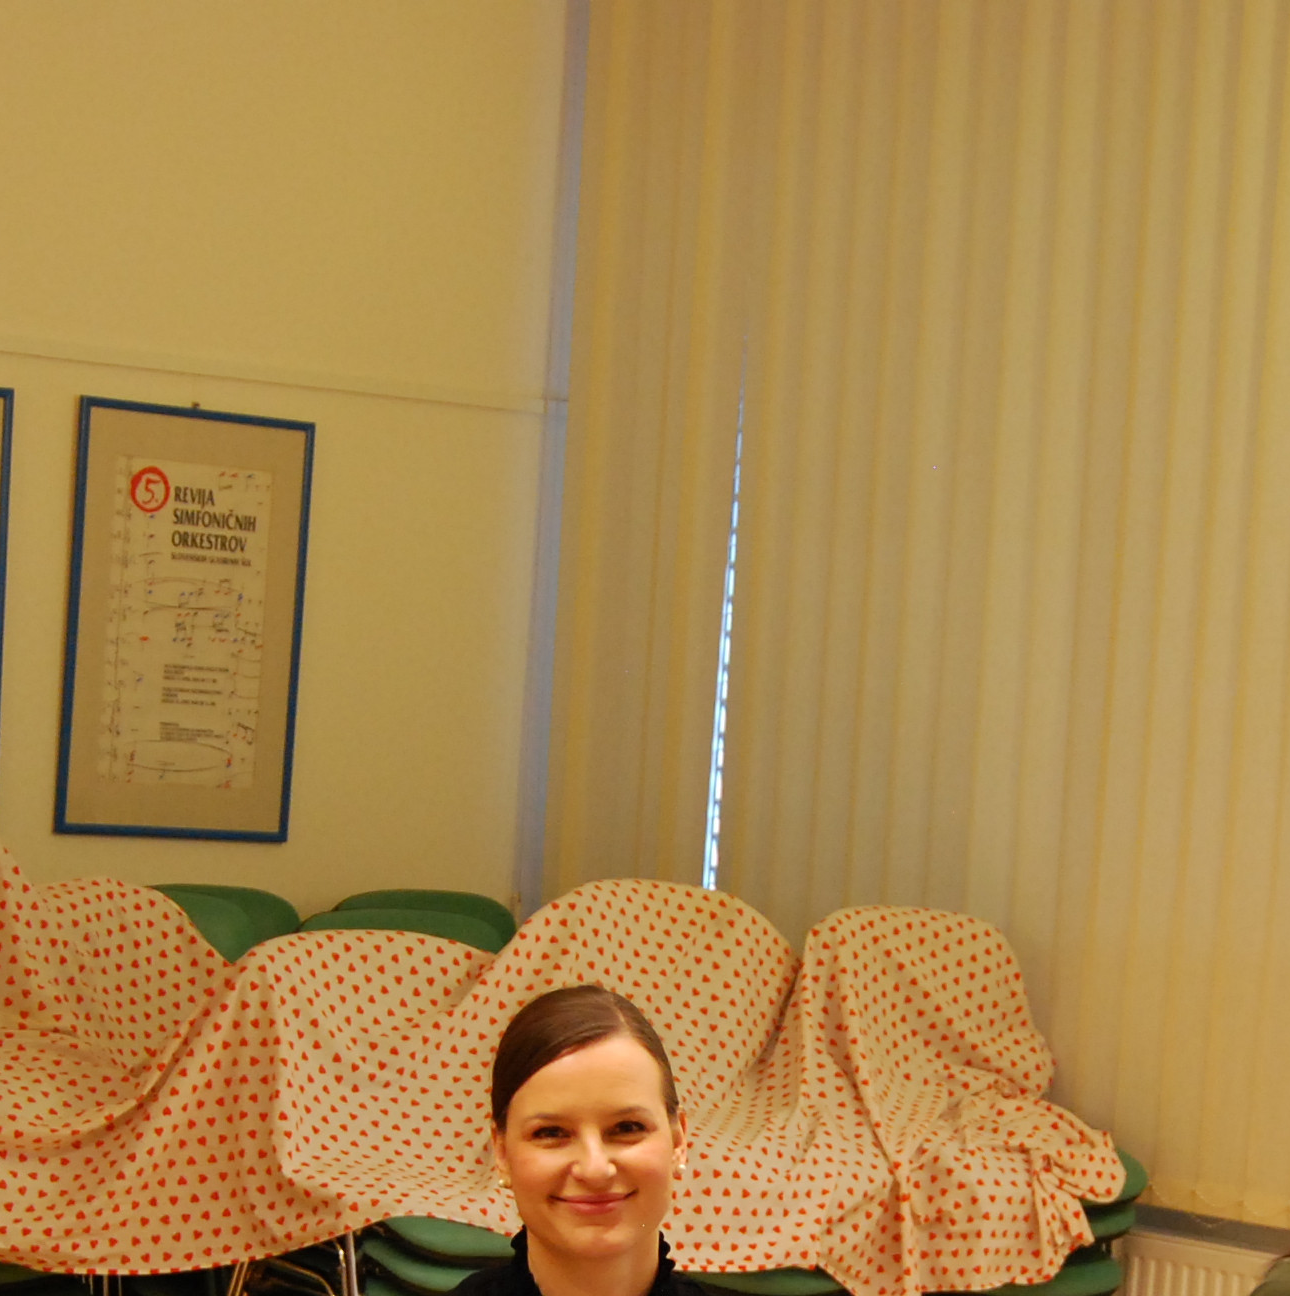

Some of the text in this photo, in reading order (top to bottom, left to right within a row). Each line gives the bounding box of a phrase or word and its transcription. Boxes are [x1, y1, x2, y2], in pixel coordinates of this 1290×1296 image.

[174, 485, 215, 509] REVIJA
[172, 508, 257, 532] SIMFONIČNIH
[171, 530, 247, 553] ORKESTROV
